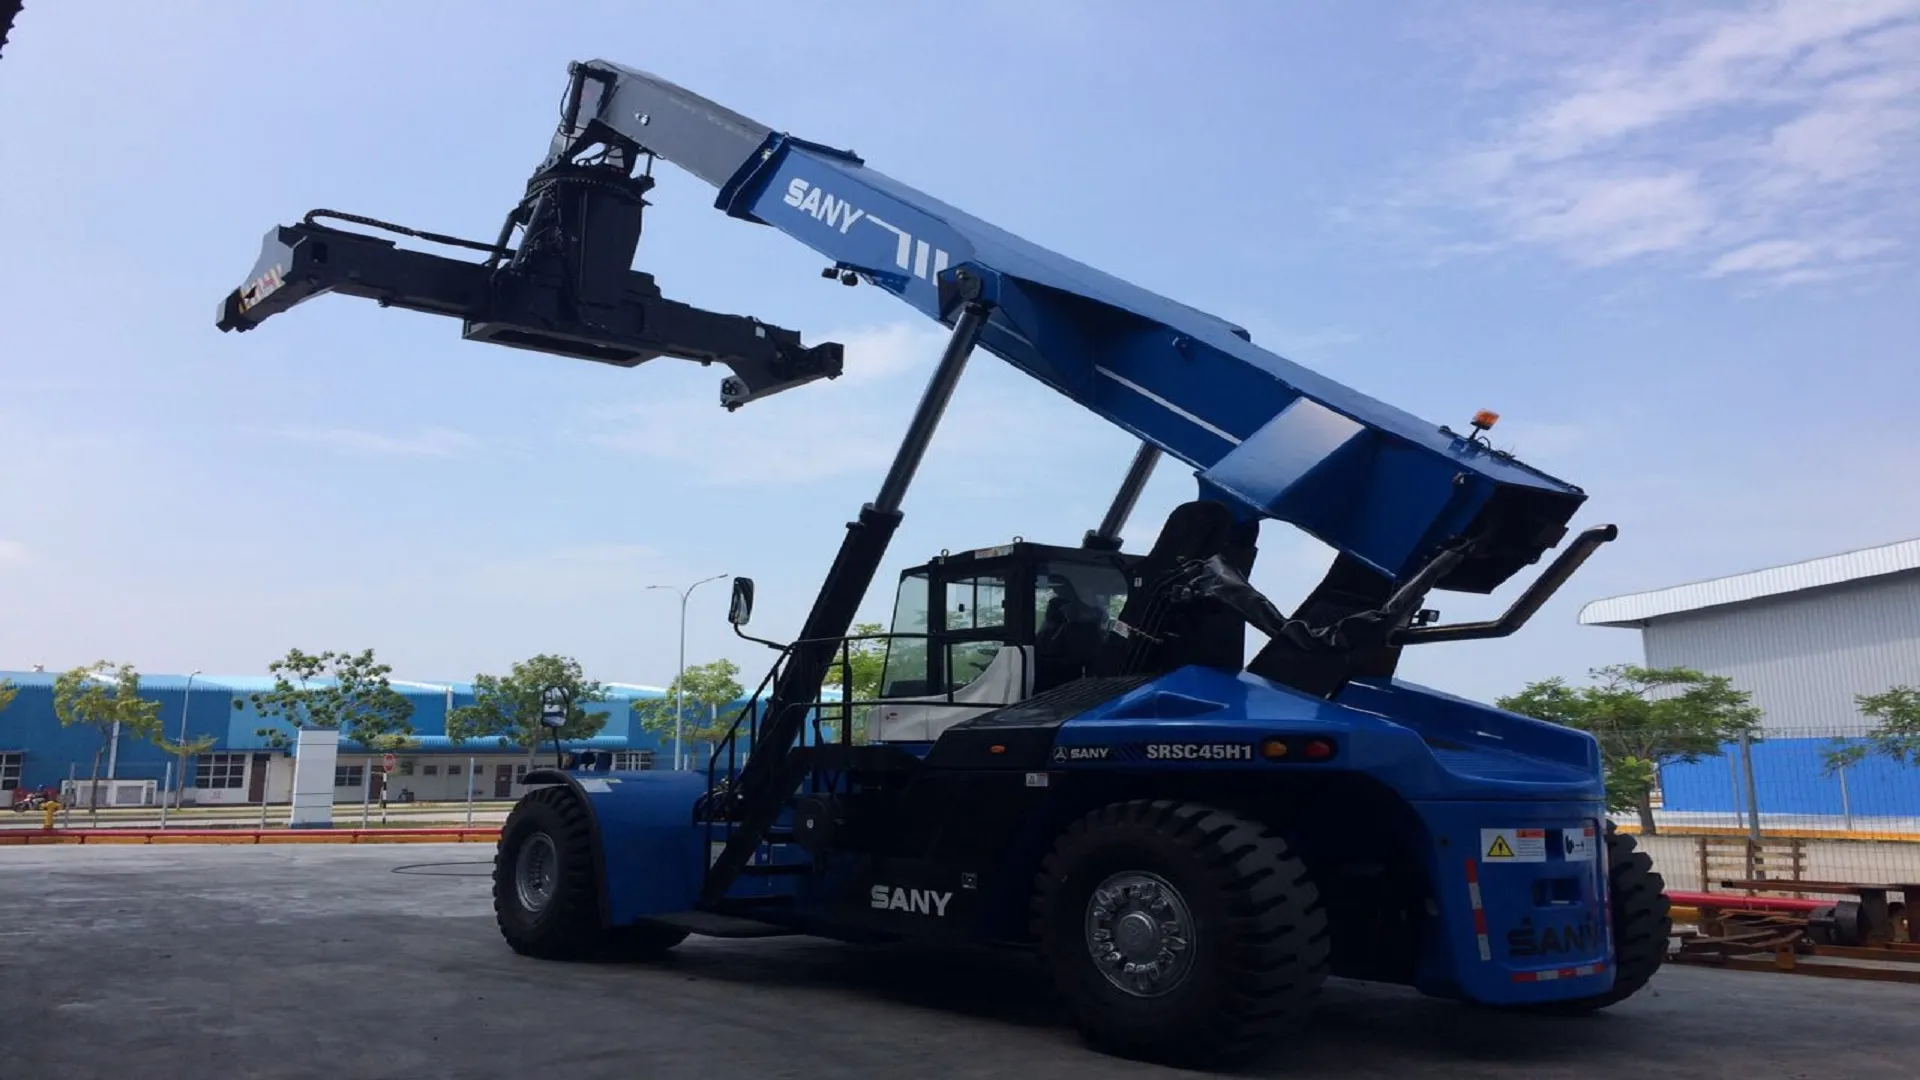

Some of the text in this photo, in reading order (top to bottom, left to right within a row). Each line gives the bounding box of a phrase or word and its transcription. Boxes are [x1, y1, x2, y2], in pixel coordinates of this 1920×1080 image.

[783, 178, 865, 234] SANY
[1070, 744, 1252, 759] SANY SRSC45H1
[870, 884, 953, 916] SANY
